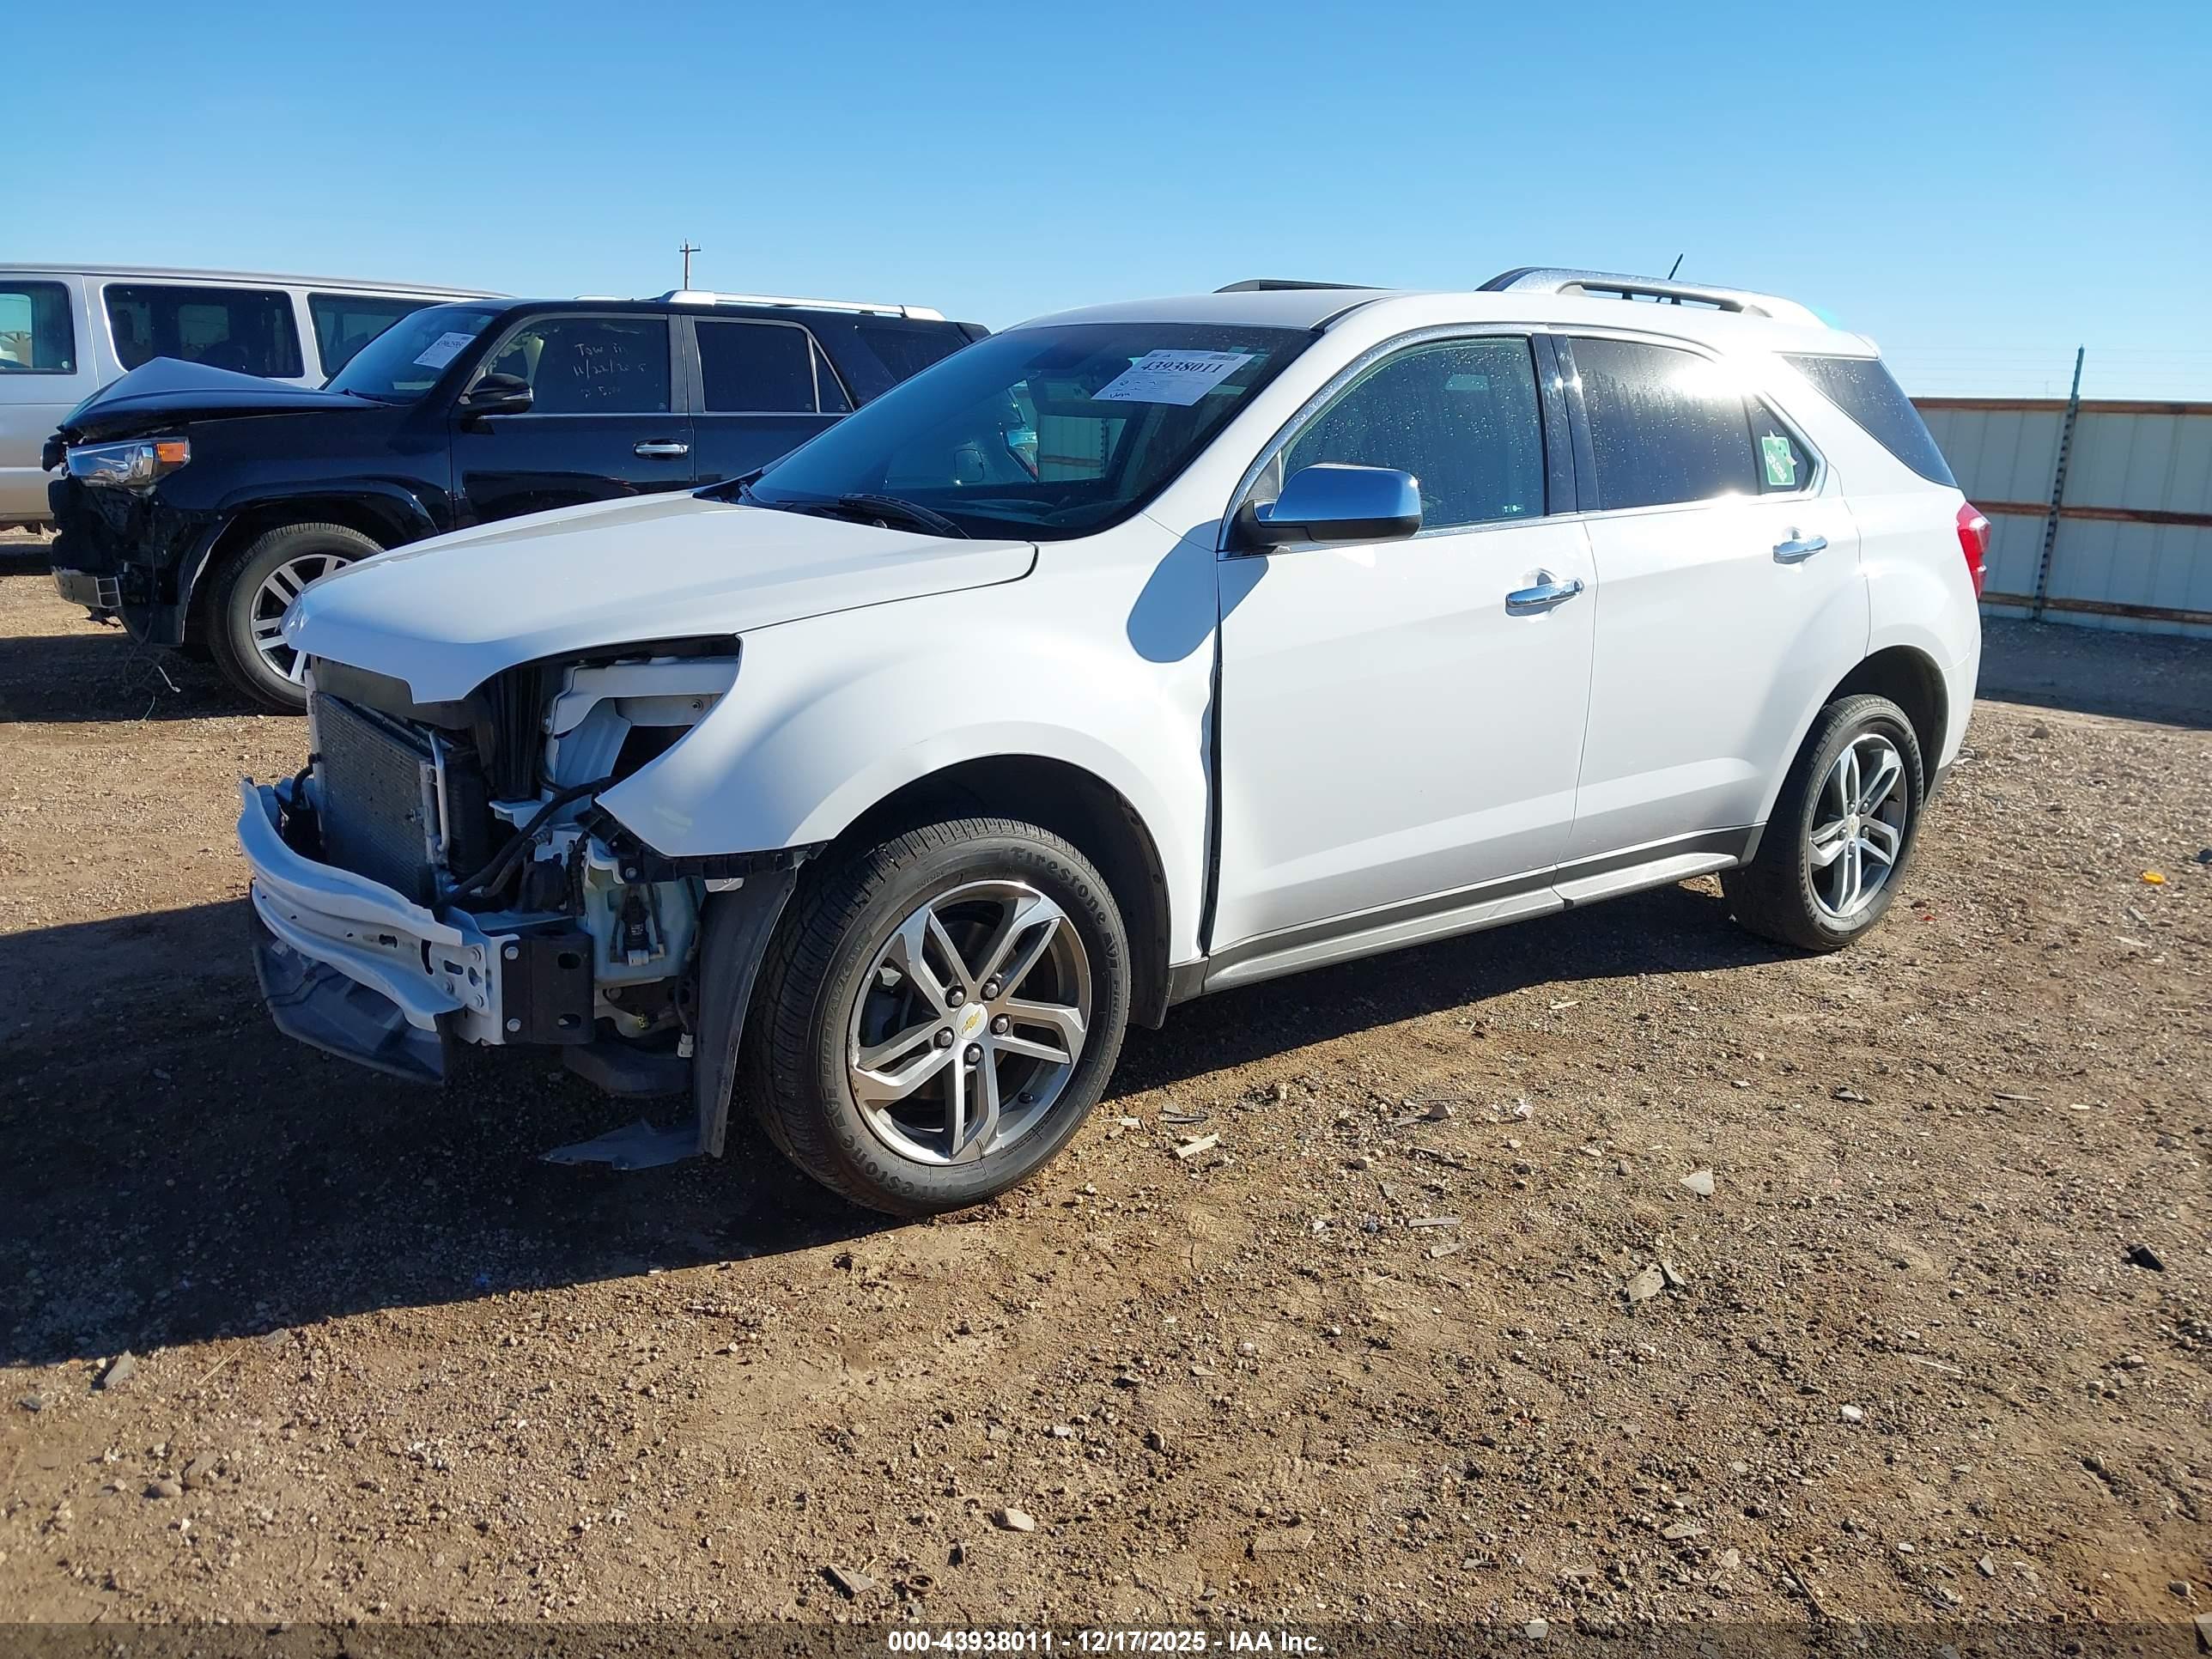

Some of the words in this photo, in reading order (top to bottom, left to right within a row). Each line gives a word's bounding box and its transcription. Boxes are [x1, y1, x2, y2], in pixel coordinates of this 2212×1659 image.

[574, 343, 604, 356] Tow
[1140, 361, 1224, 374] 43938011
[1010, 846, 1108, 926] Firestone
